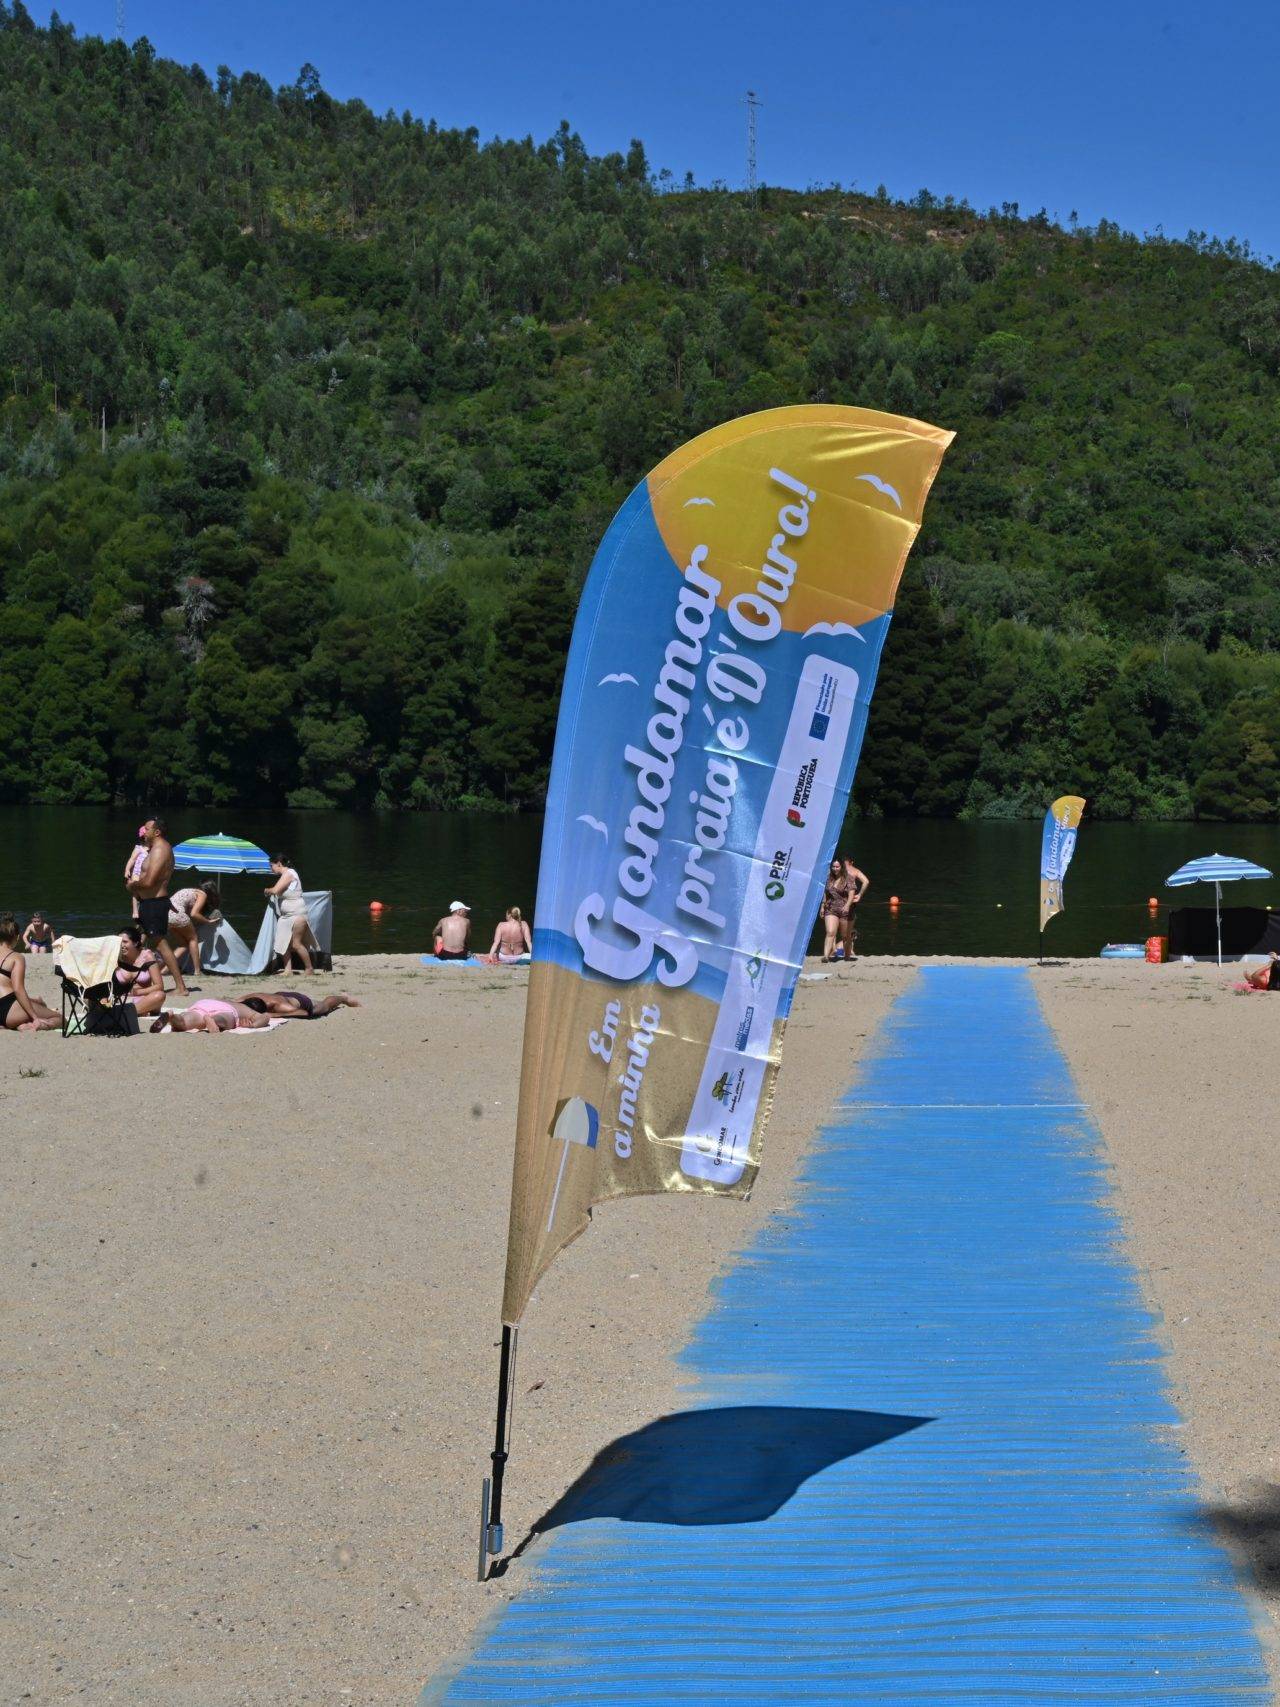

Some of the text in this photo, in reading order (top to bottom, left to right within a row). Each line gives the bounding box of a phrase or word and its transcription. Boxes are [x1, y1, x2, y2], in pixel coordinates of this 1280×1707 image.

[675, 467, 817, 929] praia é D'Ouro!
[574, 543, 722, 988] Gondomar
[792, 764, 809, 807] REPÚBLICA
[799, 758, 819, 809] PORTUGUESA
[769, 850, 788, 880] PRR
[588, 998, 621, 1064] Em
[614, 1003, 662, 1159] a minha
